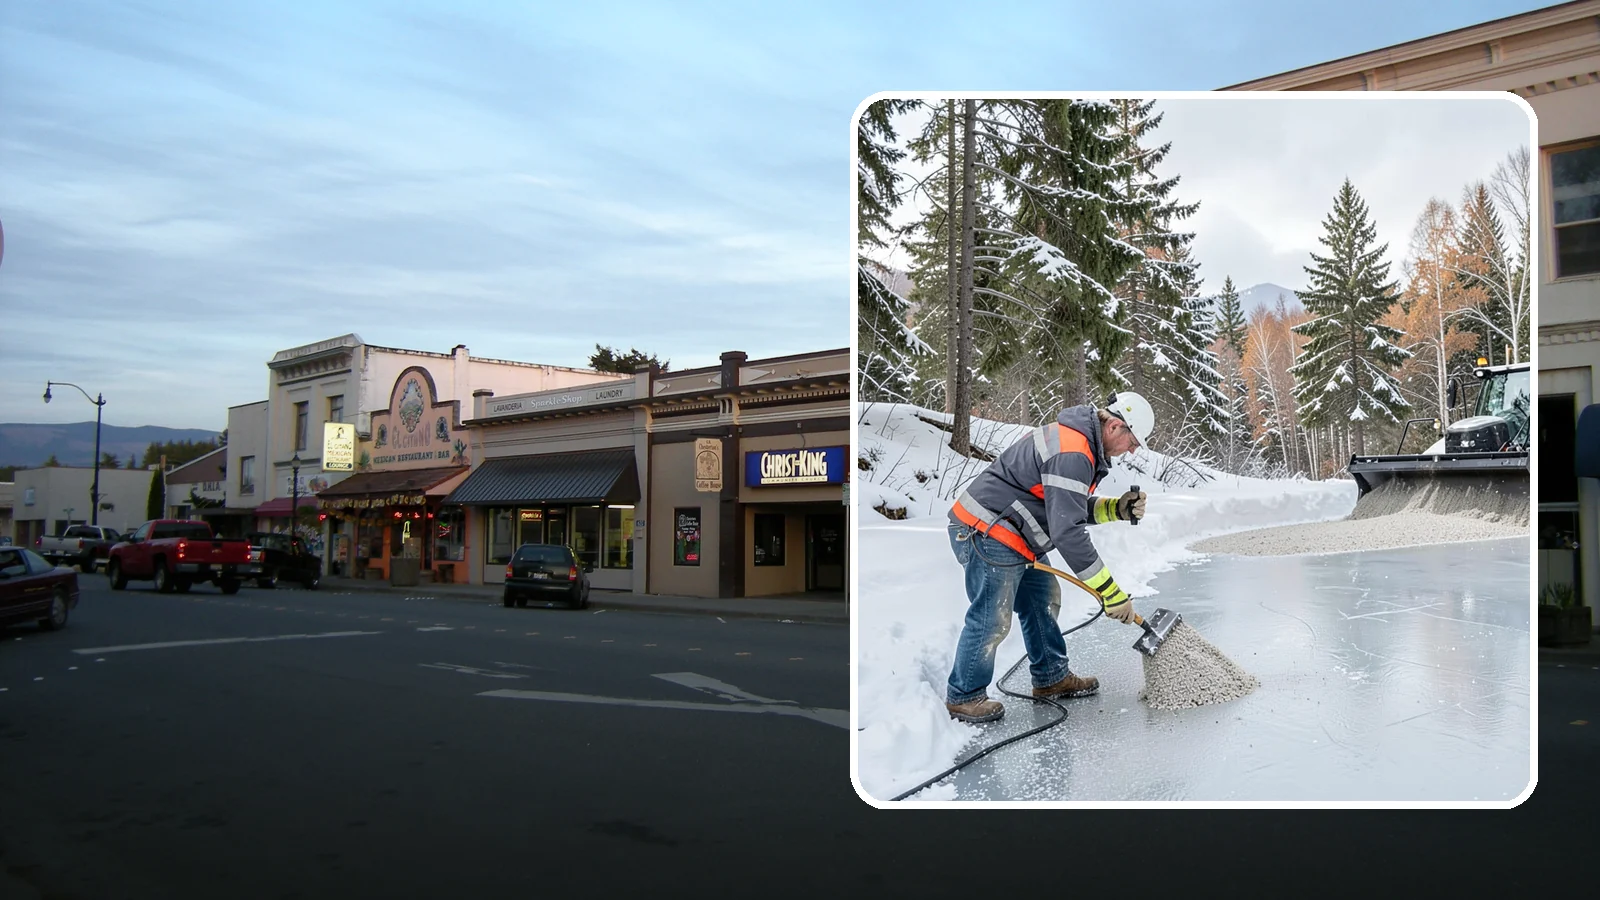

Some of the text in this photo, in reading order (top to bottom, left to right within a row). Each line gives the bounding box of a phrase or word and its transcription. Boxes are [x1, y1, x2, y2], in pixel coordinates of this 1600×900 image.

[493, 388, 624, 412] LAVANDERIA Sparkle Shop LAUNDRY
[398, 451, 434, 462] RESTAURANT
[438, 450, 450, 459] BAR
[761, 450, 827, 478] CHRIST KING
[696, 481, 722, 489] Coffee House
